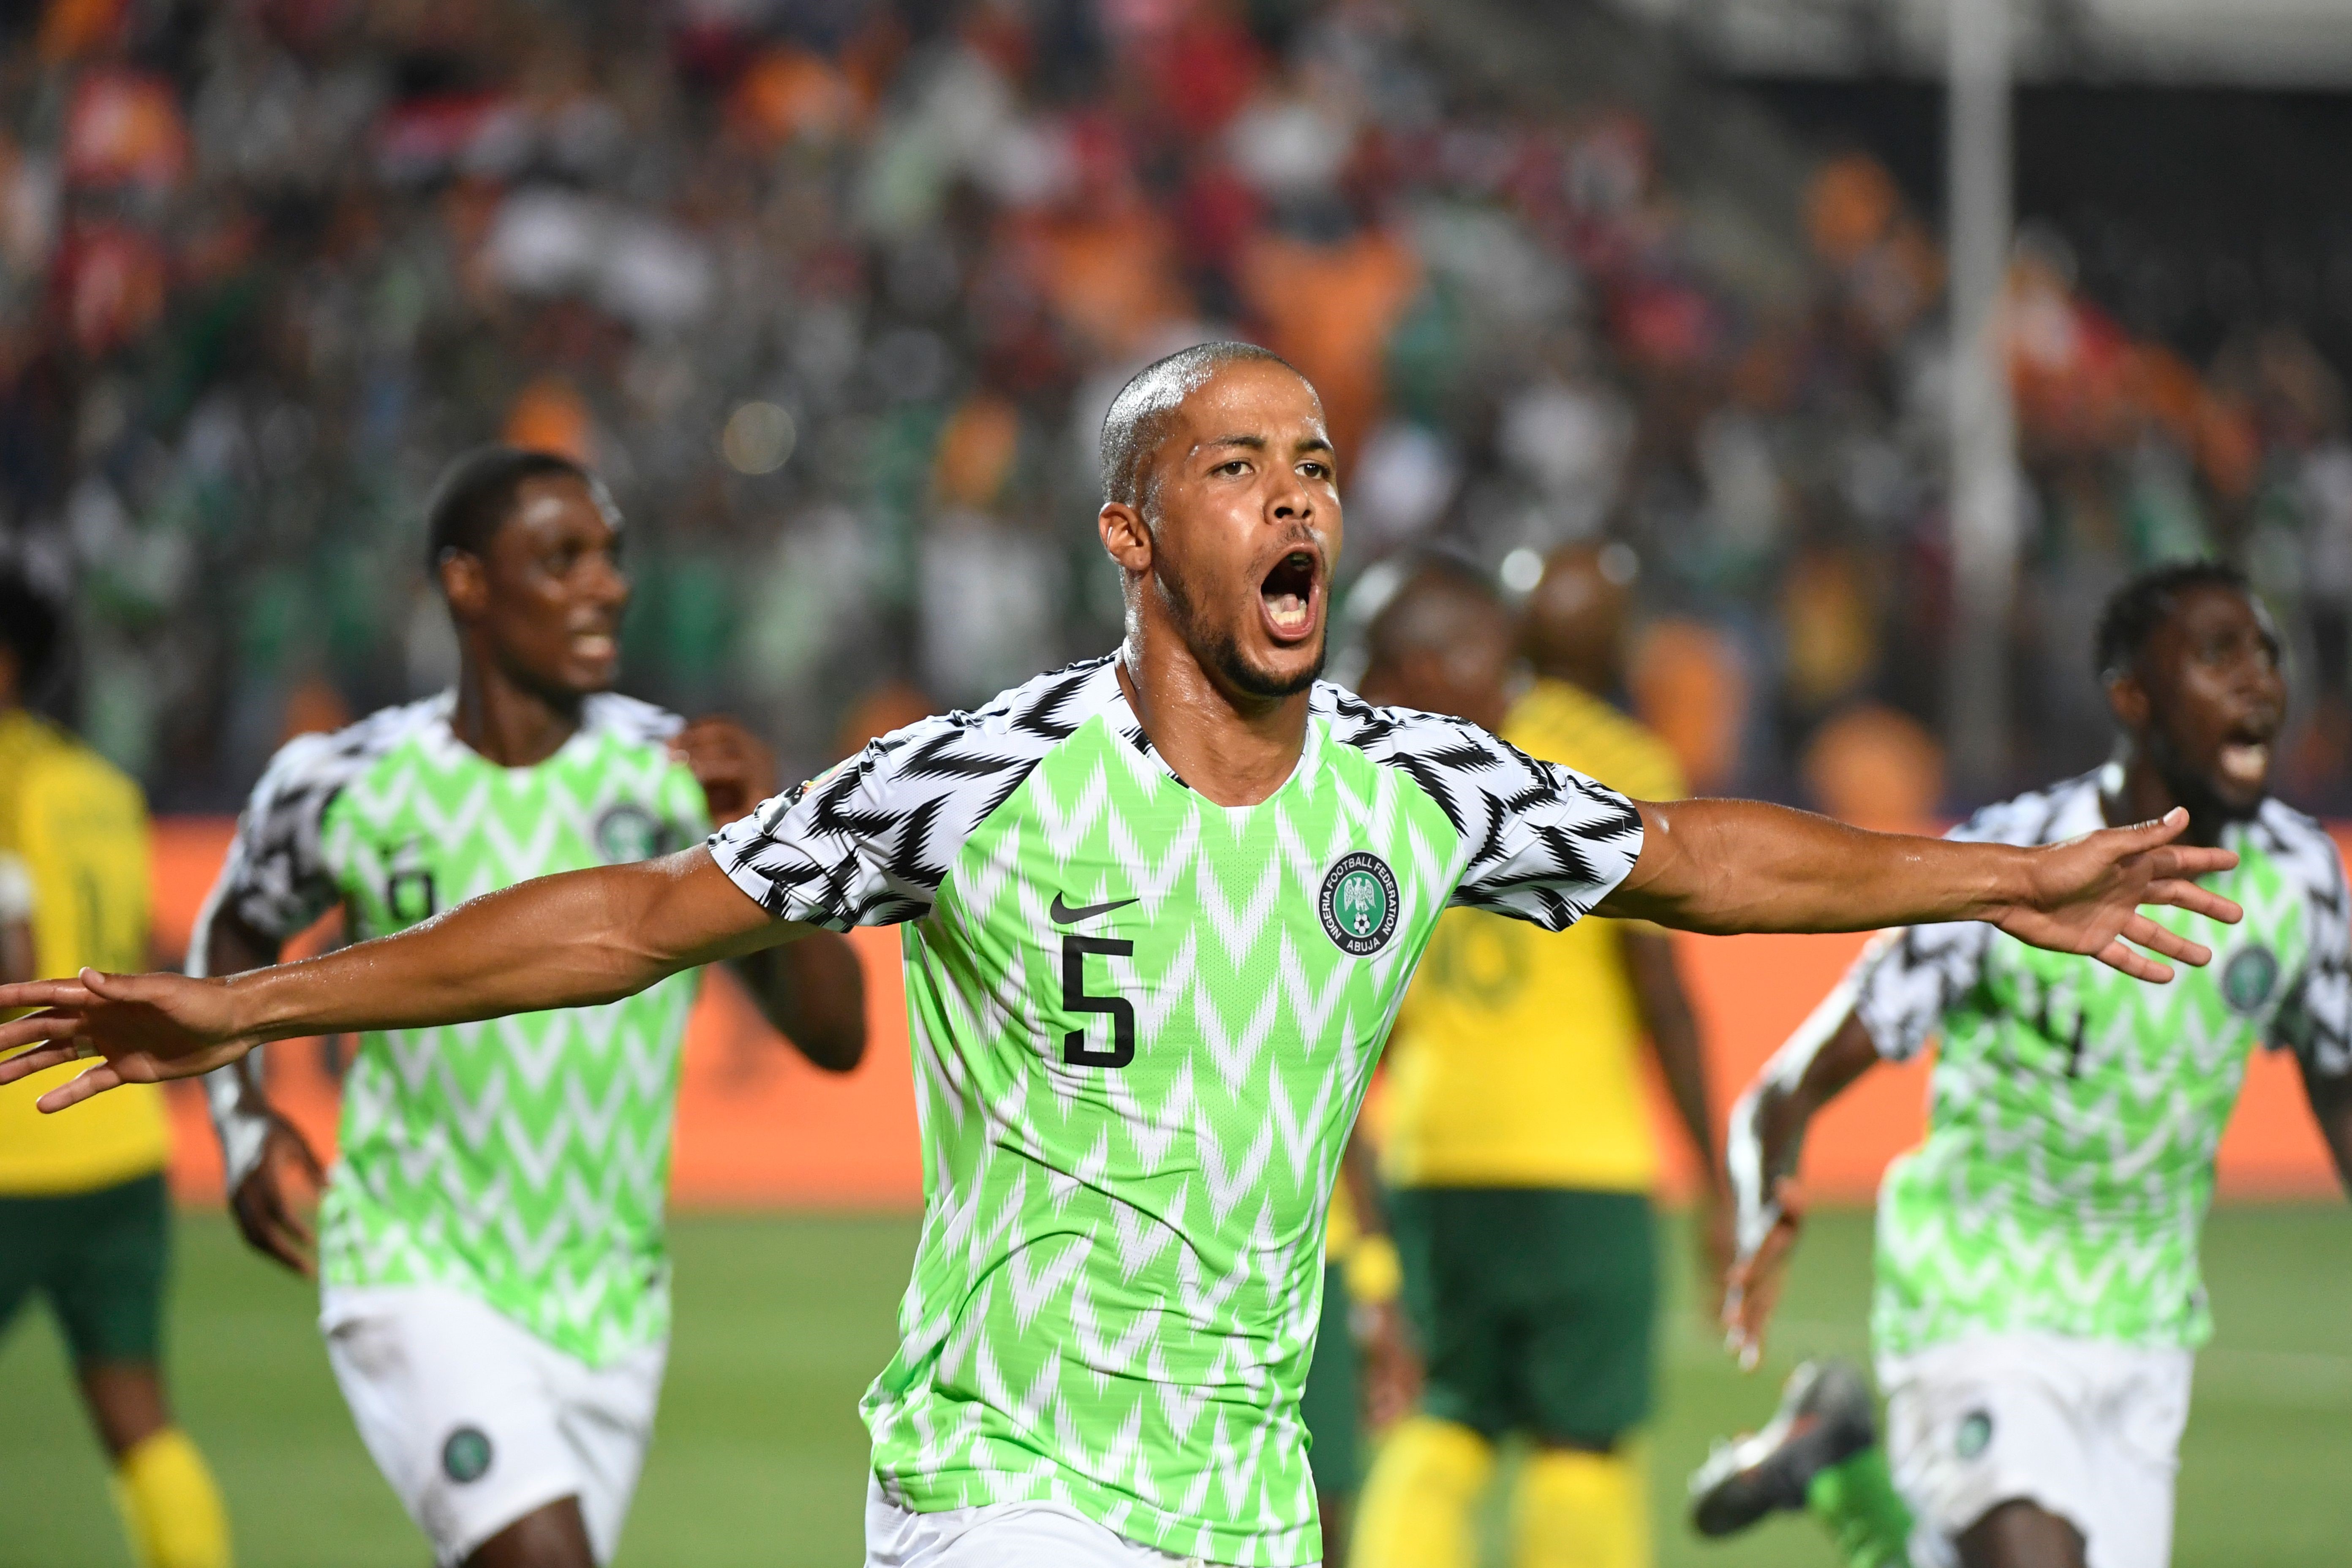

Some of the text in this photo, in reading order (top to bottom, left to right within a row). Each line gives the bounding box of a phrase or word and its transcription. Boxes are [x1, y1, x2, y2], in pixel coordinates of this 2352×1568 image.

[1322, 856, 1396, 940] NIGERIA FOOTBALL FEDERATION
[1347, 937, 1381, 952] ABUJA
[1062, 935, 1135, 1068] 5
